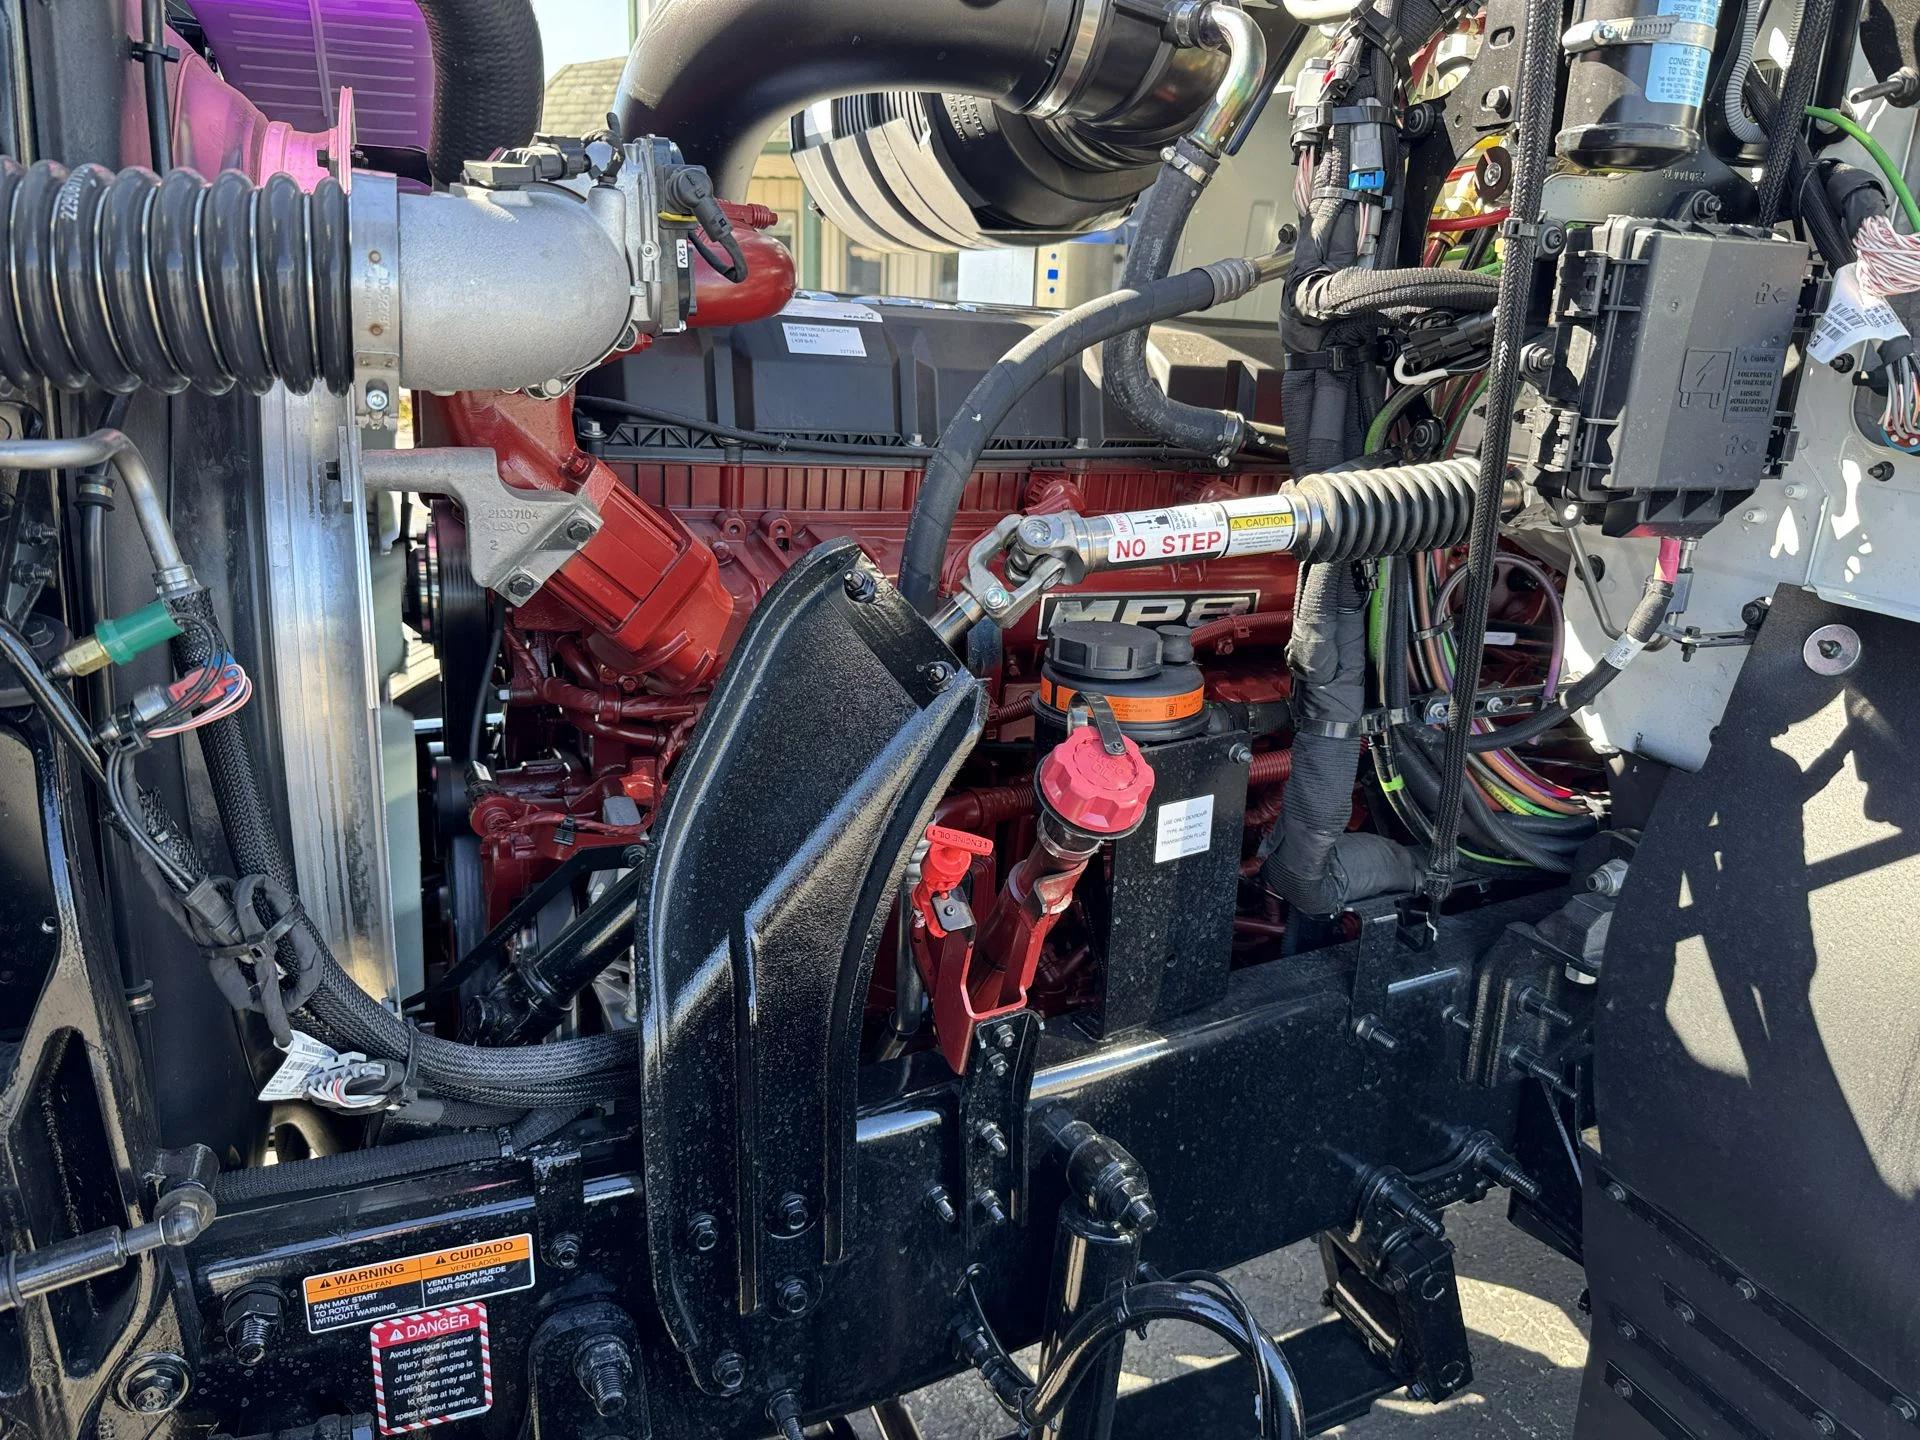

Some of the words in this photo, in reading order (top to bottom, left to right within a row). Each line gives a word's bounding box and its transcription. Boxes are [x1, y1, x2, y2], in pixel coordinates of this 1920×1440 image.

[678, 244, 687, 266] 12V
[488, 508, 539, 520] 21337104
[1246, 516, 1287, 529] CAUTION
[1116, 538, 1146, 559] NO
[1161, 530, 1222, 555] STEP
[1050, 597, 1250, 628] MP8
[937, 830, 951, 840] OIL
[952, 834, 982, 848] ENGINE
[450, 1241, 514, 1262] CUIDADO
[450, 1257, 501, 1272] VENTILADOR
[334, 1263, 405, 1286] WARNING
[427, 1271, 478, 1287] VENTILADOR
[479, 1265, 507, 1278] PUEDE
[338, 1284, 374, 1296] CLUTCH
[375, 1279, 392, 1289] FAN
[427, 1283, 453, 1295] GIRAR
[455, 1280, 469, 1290] SIN
[314, 1302, 330, 1311] FAN
[332, 1297, 350, 1307] MAY
[352, 1292, 378, 1304] START
[314, 1309, 327, 1318] TO
[328, 1302, 360, 1316] ROTATE
[315, 1312, 354, 1325] WITHOUT
[355, 1302, 398, 1318] WARNING.
[407, 1313, 470, 1338] DANGER
[389, 1348, 411, 1360] Avoid
[412, 1342, 440, 1353] serious
[441, 1334, 474, 1349] personal
[397, 1360, 420, 1371] injury,
[422, 1353, 448, 1365] remain
[449, 1348, 468, 1358] clear
[394, 1375, 403, 1383] of
[403, 1372, 416, 1381] fan
[417, 1368, 438, 1379] when
[440, 1362, 465, 1375] engine
[425, 1380, 440, 1389] Fan
[441, 1375, 458, 1386] may
[459, 1371, 476, 1380] start
[407, 1397, 415, 1405] to
[416, 1393, 438, 1403] rotate
[440, 1390, 447, 1398] at
[449, 1386, 466, 1397] high
[394, 1410, 418, 1422] speed
[419, 1403, 447, 1415] without
